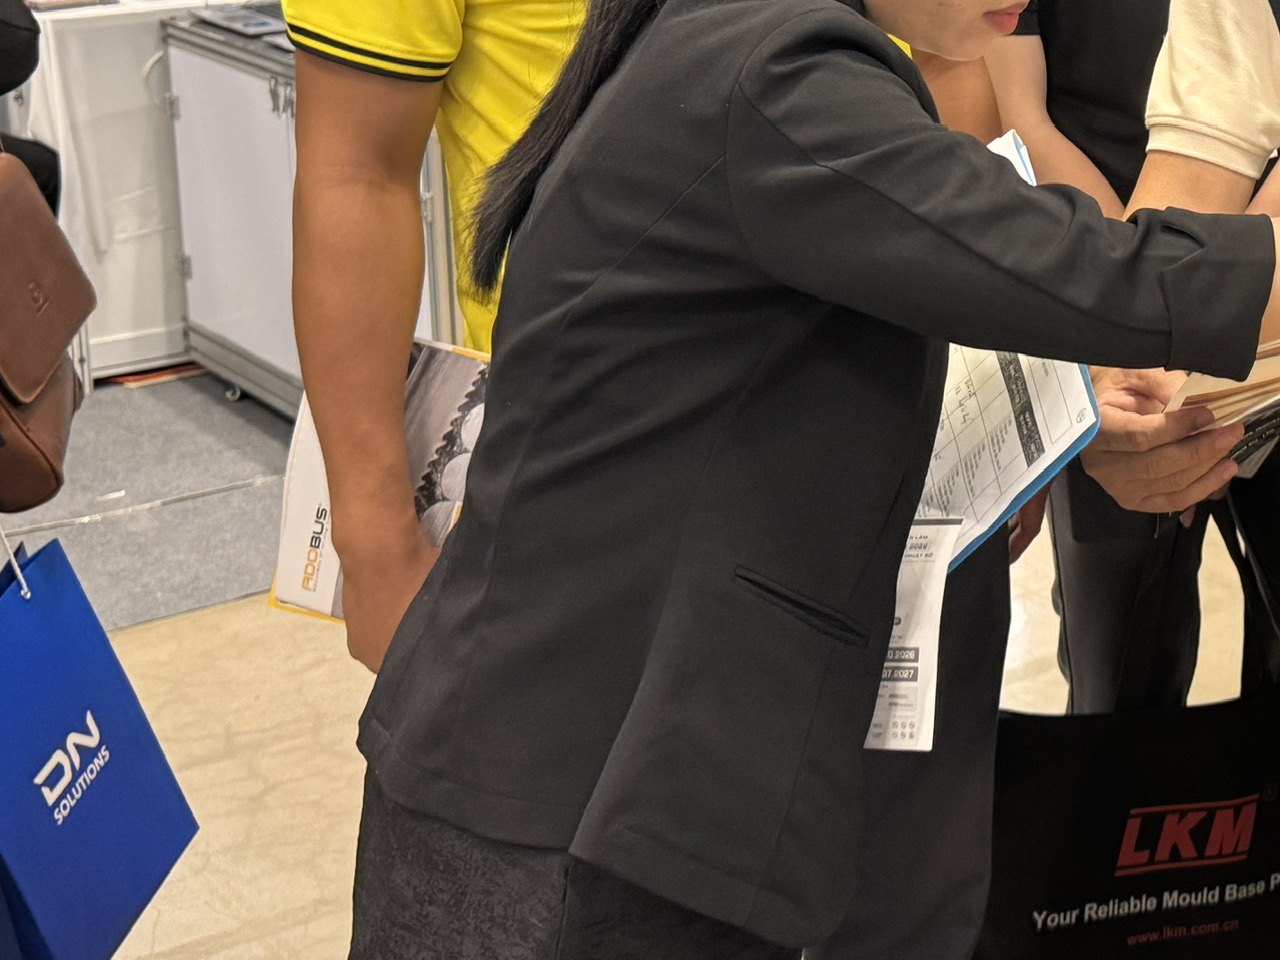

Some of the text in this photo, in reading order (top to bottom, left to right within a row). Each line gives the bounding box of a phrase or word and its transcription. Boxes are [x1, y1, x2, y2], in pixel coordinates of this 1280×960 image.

[301, 506, 328, 592] ADOBUS
[33, 709, 101, 808] DN
[53, 744, 111, 826] SOLUTIONS
[1115, 800, 1260, 868] LKM
[1032, 906, 1079, 932] Your
[1084, 892, 1158, 922] Reliable
[1162, 886, 1220, 911] Mould
[1225, 881, 1266, 902] Base
[1126, 918, 1240, 946] www.lkm.com.cn
